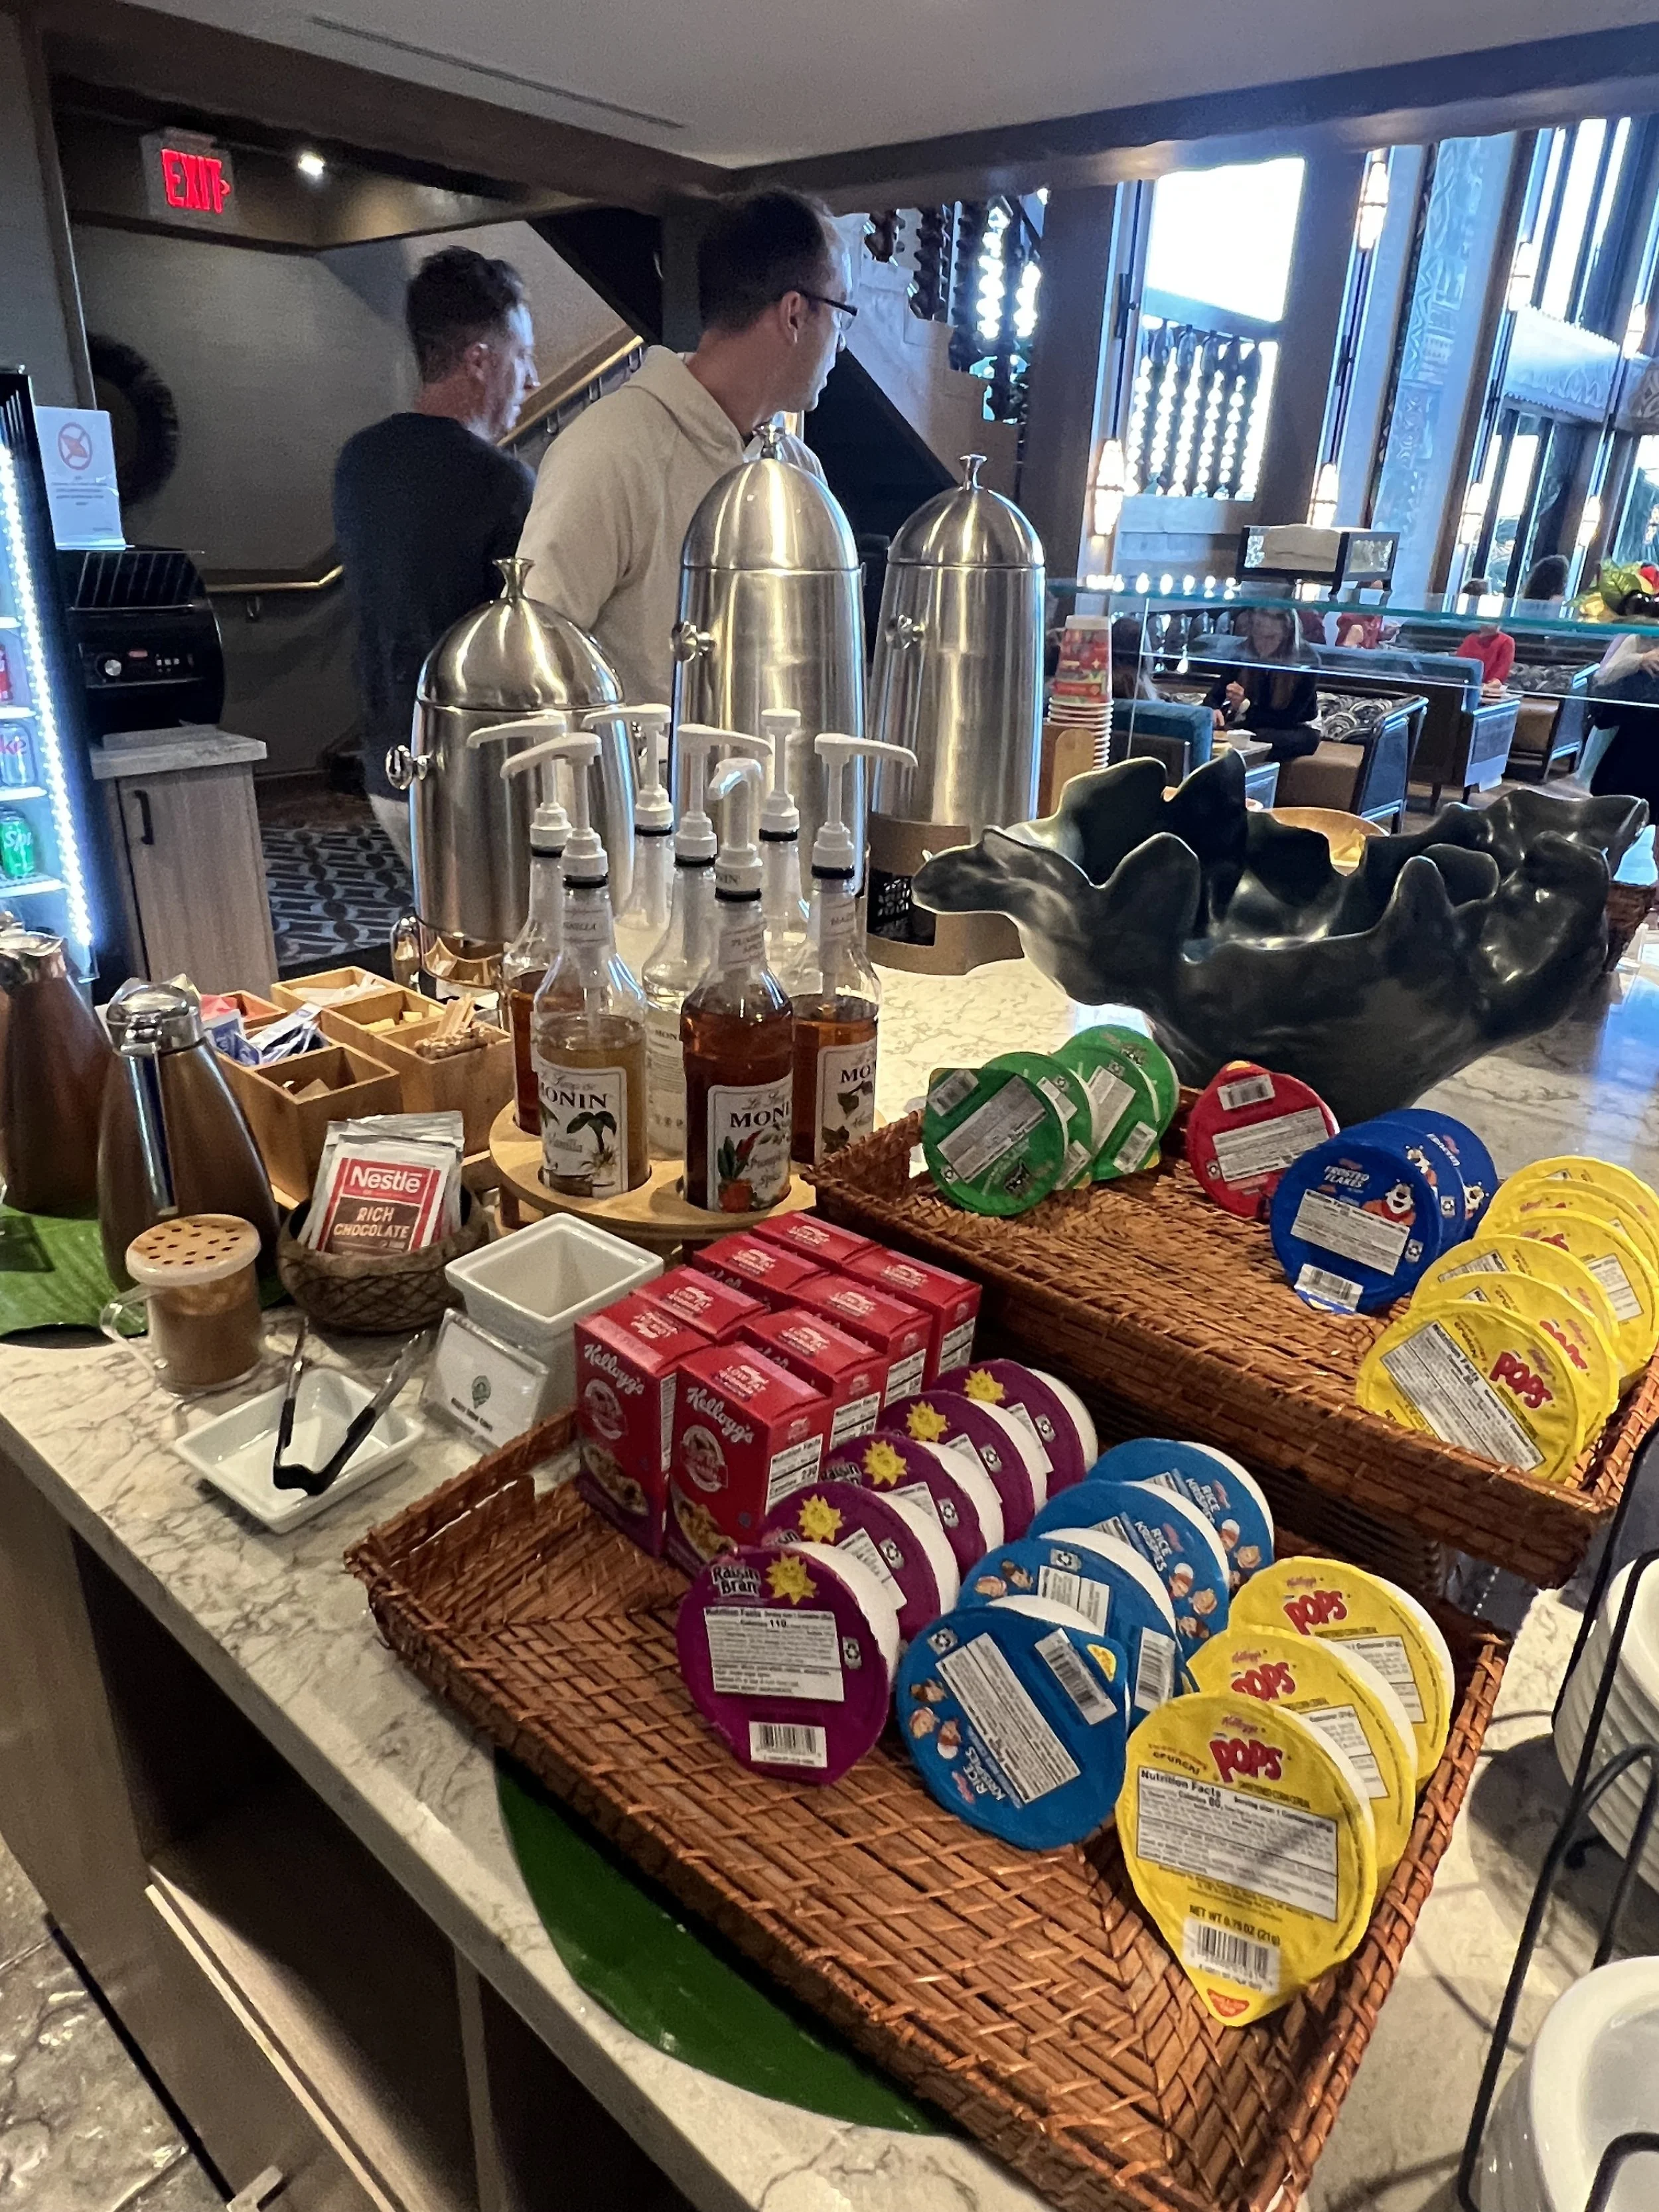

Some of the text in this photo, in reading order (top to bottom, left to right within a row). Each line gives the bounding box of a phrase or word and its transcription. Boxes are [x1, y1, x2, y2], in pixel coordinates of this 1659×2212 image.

[161, 148, 223, 214] EXIT
[841, 1062, 877, 1084] MO
[357, 1207, 394, 1222] RICH
[333, 1223, 411, 1239] CHOCOLATE
[584, 1343, 644, 1394] Kellogg's
[1489, 1351, 1553, 1409] POPS
[687, 1386, 755, 1444] Kellogg's
[713, 1565, 759, 1581] Raisin
[721, 1580, 757, 1594] Bran
[1283, 1589, 1348, 1636] POPS
[1209, 1737, 1283, 1783] POPS
[963, 1765, 988, 1794] RICE
[1189, 1904, 1206, 1917] NET
[1209, 1908, 1222, 1923] WT
